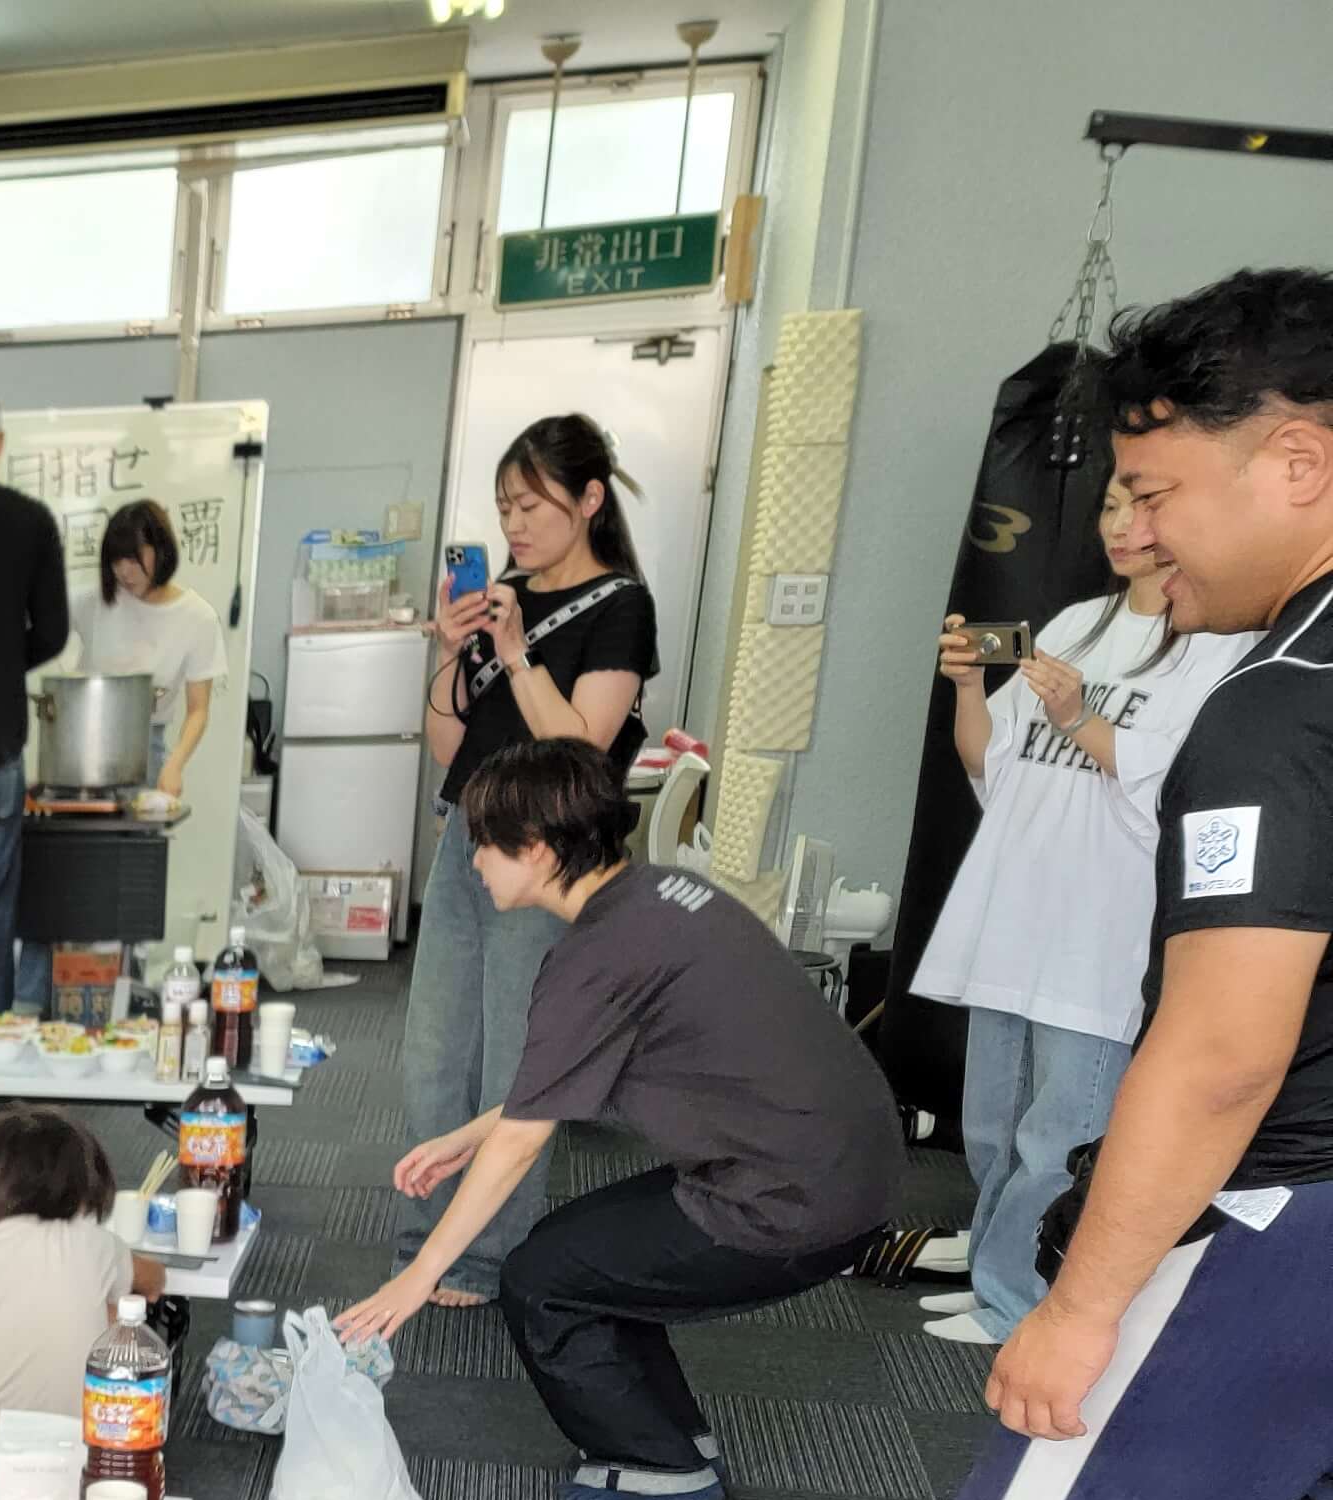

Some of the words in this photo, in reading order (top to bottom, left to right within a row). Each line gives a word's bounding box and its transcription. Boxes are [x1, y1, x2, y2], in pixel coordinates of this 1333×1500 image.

[535, 225, 684, 272] 非常出口
[566, 267, 645, 295] EXIT
[7, 445, 149, 499] 目指せ
